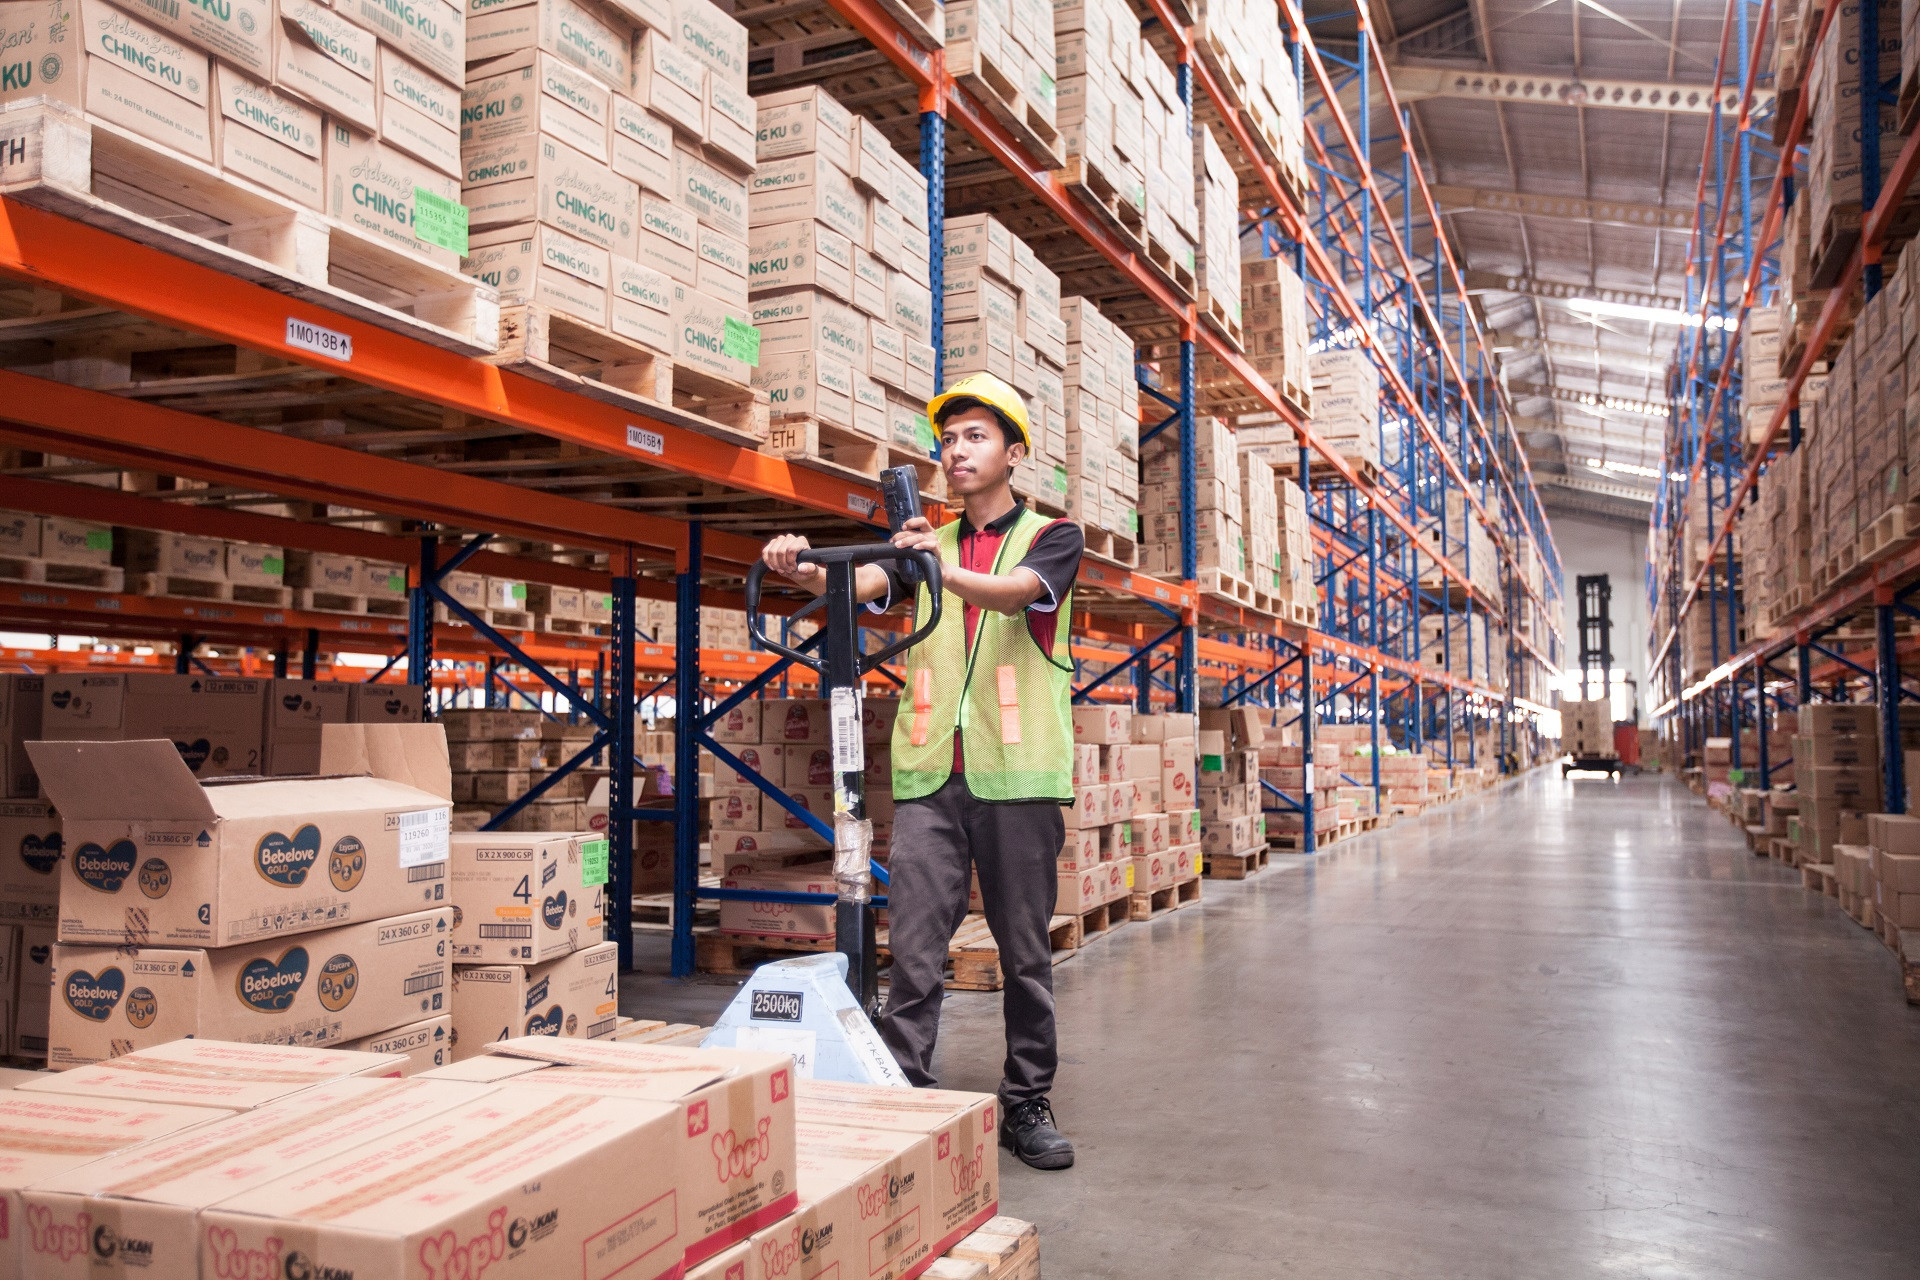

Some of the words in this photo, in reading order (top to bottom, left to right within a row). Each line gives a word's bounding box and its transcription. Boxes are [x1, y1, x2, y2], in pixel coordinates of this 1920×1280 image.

[418, 13, 437, 39] KU
[340, 43, 358, 64] KU
[560, 22, 596, 57] CHING
[597, 45, 612, 68] KU
[682, 24, 715, 57] CHING
[717, 47, 729, 67] KU
[101, 34, 156, 74] CHING
[160, 61, 181, 86] KU
[2, 60, 32, 92] KU
[393, 79, 428, 109] CHING
[429, 100, 444, 117] KU
[547, 78, 576, 103] CHING
[577, 94, 590, 110] KU
[124, 98, 145, 115] BOTOL
[145, 108, 174, 127] KEMASAN
[486, 100, 505, 120] KU
[235, 98, 279, 131] CHING
[281, 120, 300, 143] KU
[620, 117, 646, 139] CHING
[647, 131, 658, 145] KU
[771, 125, 787, 139] KU
[468, 165, 499, 182] CHING
[501, 162, 515, 175] KU
[754, 175, 782, 189] CHING
[783, 172, 796, 183] KU
[352, 184, 406, 224] CHING
[688, 178, 717, 205] CHING
[719, 195, 731, 212] KU
[556, 190, 596, 223] CHING
[598, 210, 616, 232] KU
[354, 214, 381, 233] Cepat
[556, 216, 577, 232] Cepat
[645, 213, 670, 232] CHING
[671, 227, 682, 239] KU
[546, 248, 575, 269] CHING
[577, 260, 590, 275] KU
[702, 243, 725, 263] CHING
[726, 255, 735, 267] KU
[771, 257, 788, 273] KU
[622, 281, 647, 300] CHING
[649, 290, 660, 304] KU
[753, 306, 779, 321] CHING
[781, 306, 793, 317] KU
[289, 322, 338, 352] 1M013B
[685, 327, 717, 354] CHING
[686, 350, 702, 362] Cepat
[770, 388, 788, 403] KU
[628, 428, 658, 450] 1M015B
[772, 430, 795, 449] ETH
[248, 750, 257, 768] 2
[386, 816, 395, 826] 24
[434, 812, 447, 821] 116
[147, 834, 156, 843] 24
[157, 835, 163, 843] X
[162, 835, 174, 843] 360
[404, 829, 430, 841] 119260
[79, 855, 130, 872] Bebelove
[262, 848, 314, 866] Bebelove
[523, 852, 532, 860] SP
[84, 871, 103, 880] GOLD
[267, 865, 289, 875] GOLD
[513, 874, 532, 904] 4
[546, 905, 564, 916] Bebelac
[594, 889, 602, 913] 4
[202, 907, 209, 921] 2
[262, 917, 269, 928] 9
[380, 930, 390, 941] 24
[391, 929, 398, 939] X
[398, 926, 413, 938] 360
[413, 924, 419, 934] G
[421, 923, 431, 933] SP
[437, 942, 444, 955] 2
[135, 963, 143, 971] 24
[143, 964, 149, 972] X
[149, 964, 161, 972] 360
[328, 960, 351, 971] Ezycare
[244, 970, 302, 993] Bebelove
[464, 971, 469, 979] 6
[470, 971, 475, 979] X
[476, 972, 480, 980] 2
[480, 972, 485, 980] X
[485, 973, 497, 981] 900
[502, 974, 511, 982] SP
[606, 973, 616, 999] 4
[69, 984, 118, 1000] Bebelove
[251, 991, 274, 1002] GOLD
[74, 999, 93, 1008] GOLD
[754, 993, 800, 1018] 2500kg
[531, 1022, 558, 1036] Bebelac
[384, 1041, 391, 1052] X
[392, 1038, 407, 1050] 360
[408, 1036, 415, 1046] G
[417, 1033, 428, 1043] SP
[435, 1051, 442, 1065] 2
[712, 1115, 771, 1184] Yupi
[951, 1144, 983, 1195] Yupi
[857, 1173, 889, 1220] Yupi
[27, 1204, 92, 1262] Yupi
[420, 1205, 508, 1280] Yupi
[209, 1225, 284, 1280] Yupi
[761, 1225, 801, 1280] Yupi
